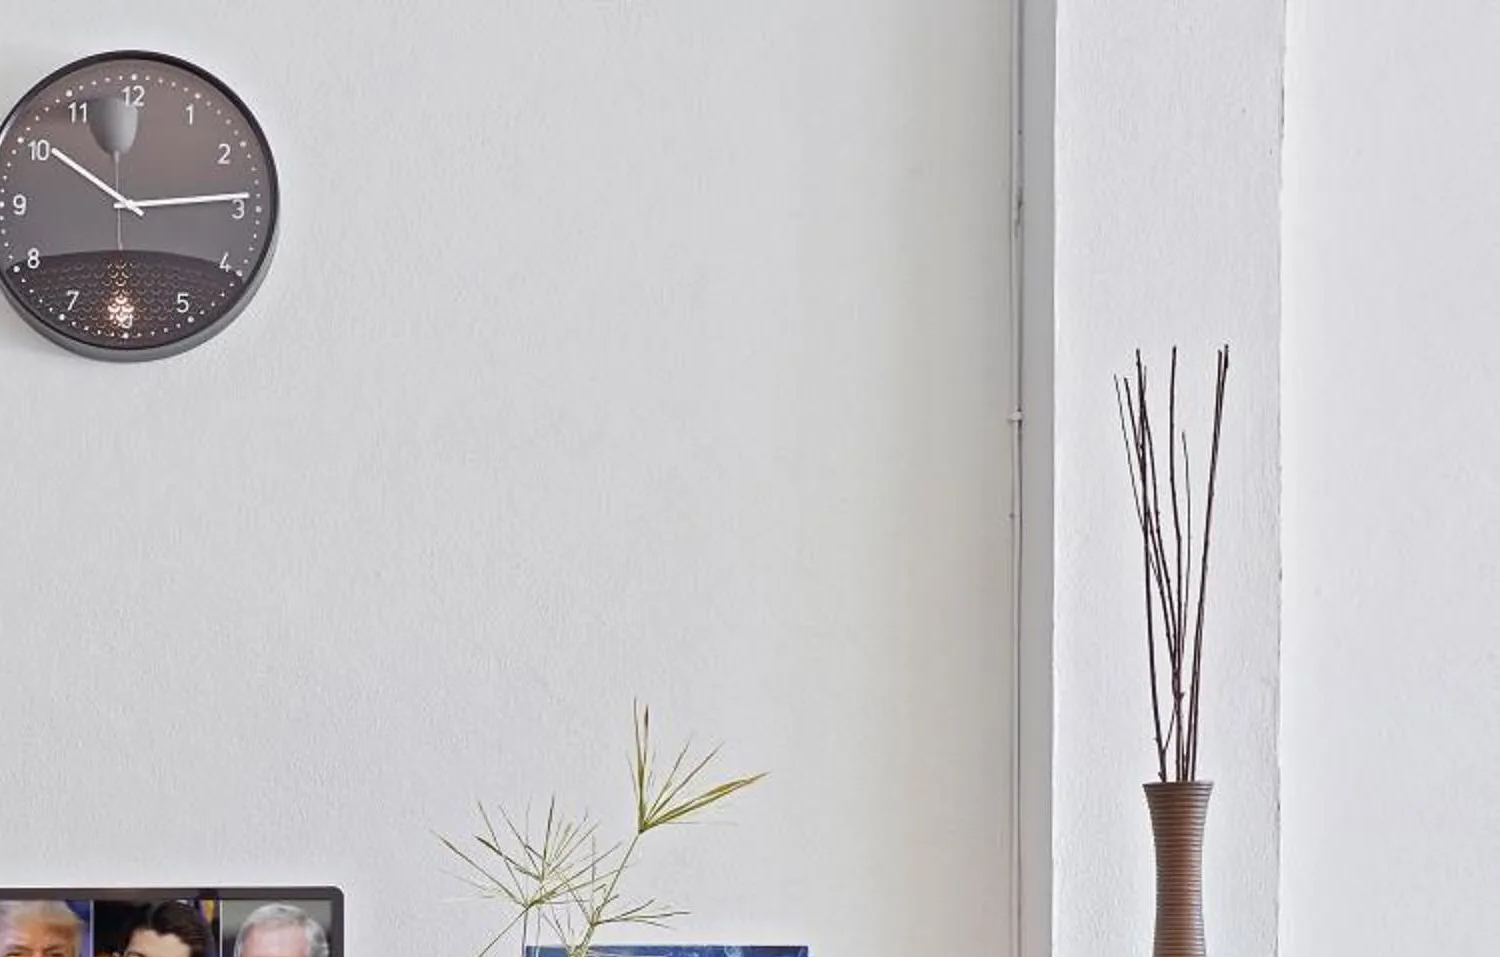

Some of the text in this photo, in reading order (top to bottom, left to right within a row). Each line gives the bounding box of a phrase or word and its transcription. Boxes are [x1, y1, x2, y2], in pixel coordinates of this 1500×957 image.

[121, 84, 145, 107] 12
[68, 102, 88, 124] 11
[186, 104, 194, 124] 1
[27, 139, 51, 161] 10
[217, 142, 231, 165] 2
[12, 195, 27, 215] 9
[231, 199, 246, 219] 3
[27, 248, 40, 269] 8
[219, 252, 231, 272] 4
[66, 290, 80, 311] 7
[176, 293, 189, 313] 5
